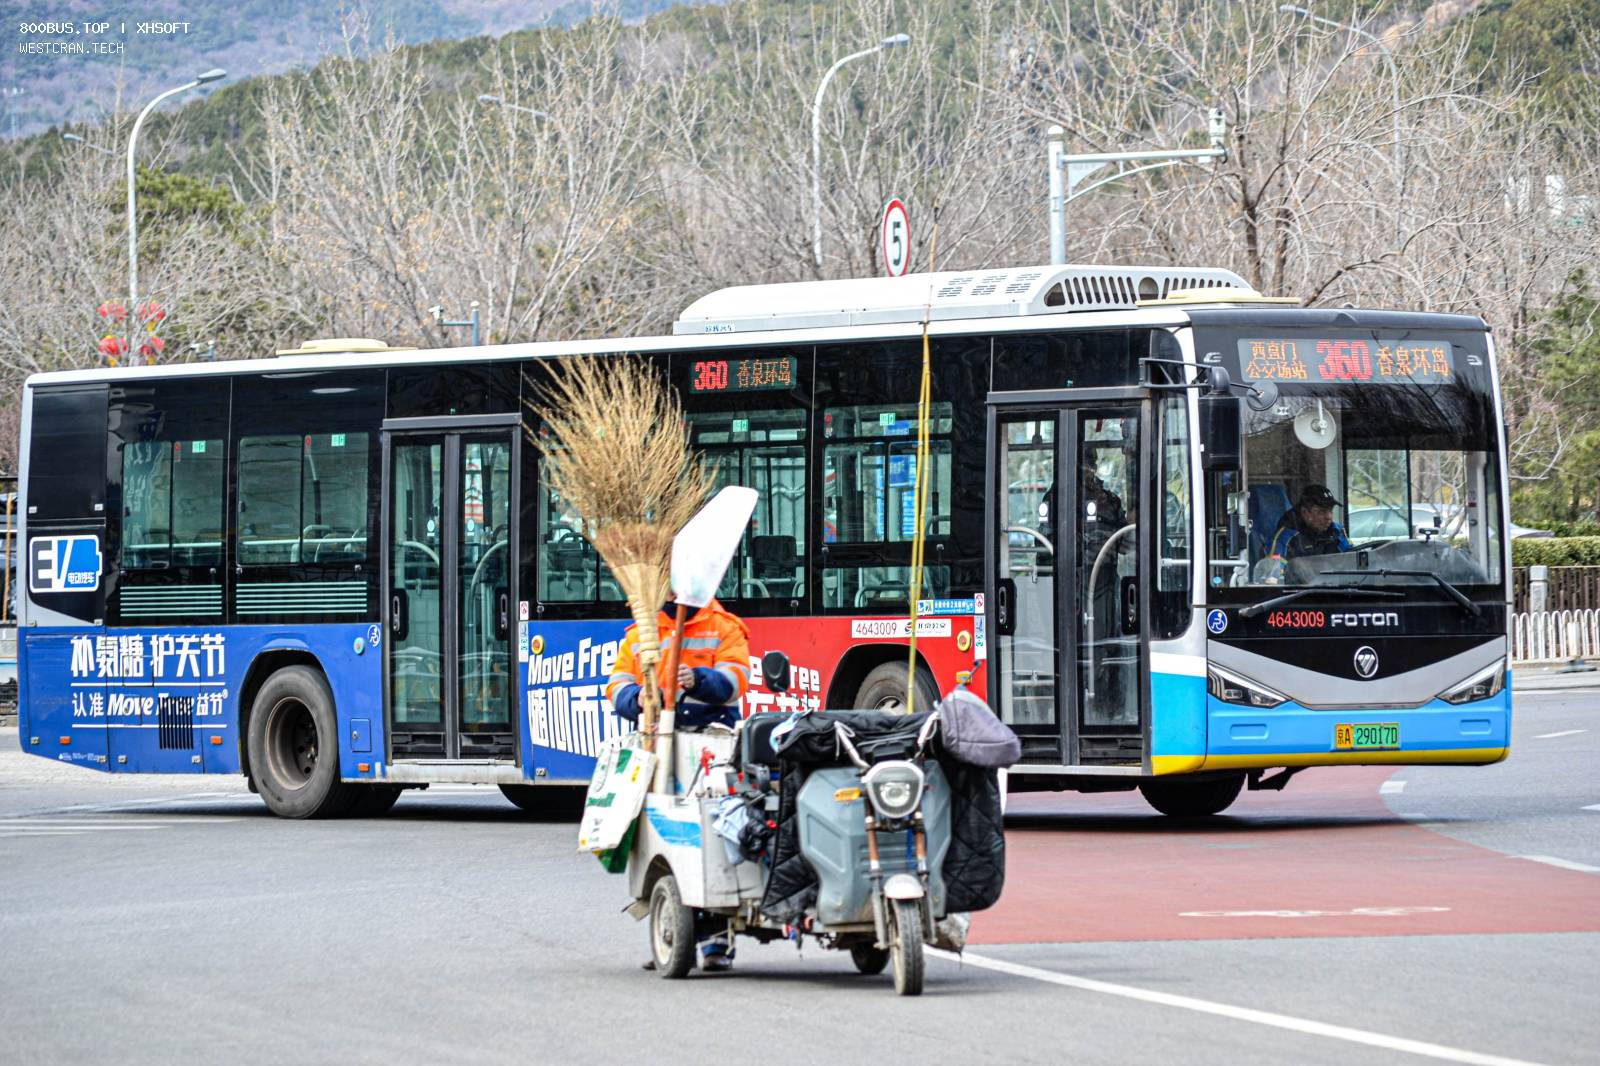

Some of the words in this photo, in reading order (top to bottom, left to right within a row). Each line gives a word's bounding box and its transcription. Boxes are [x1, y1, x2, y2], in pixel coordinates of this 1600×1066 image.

[893, 221, 902, 266] 5
[1248, 341, 1297, 361] 西直门
[1315, 341, 1372, 380] 360
[1376, 347, 1449, 377] 香泉环岛
[694, 361, 728, 391] 360
[737, 357, 791, 388] 香泉环岛
[1246, 360, 1308, 380] 公交场站
[855, 622, 897, 636] 4643009
[1267, 611, 1325, 628] 4643009
[1331, 612, 1399, 627] FOTON
[70, 634, 144, 677] 补氨糖
[150, 633, 225, 677] 护关节
[527, 652, 575, 686] Move
[577, 637, 628, 680] Fre
[72, 692, 104, 717] 认准
[107, 692, 154, 716] Move
